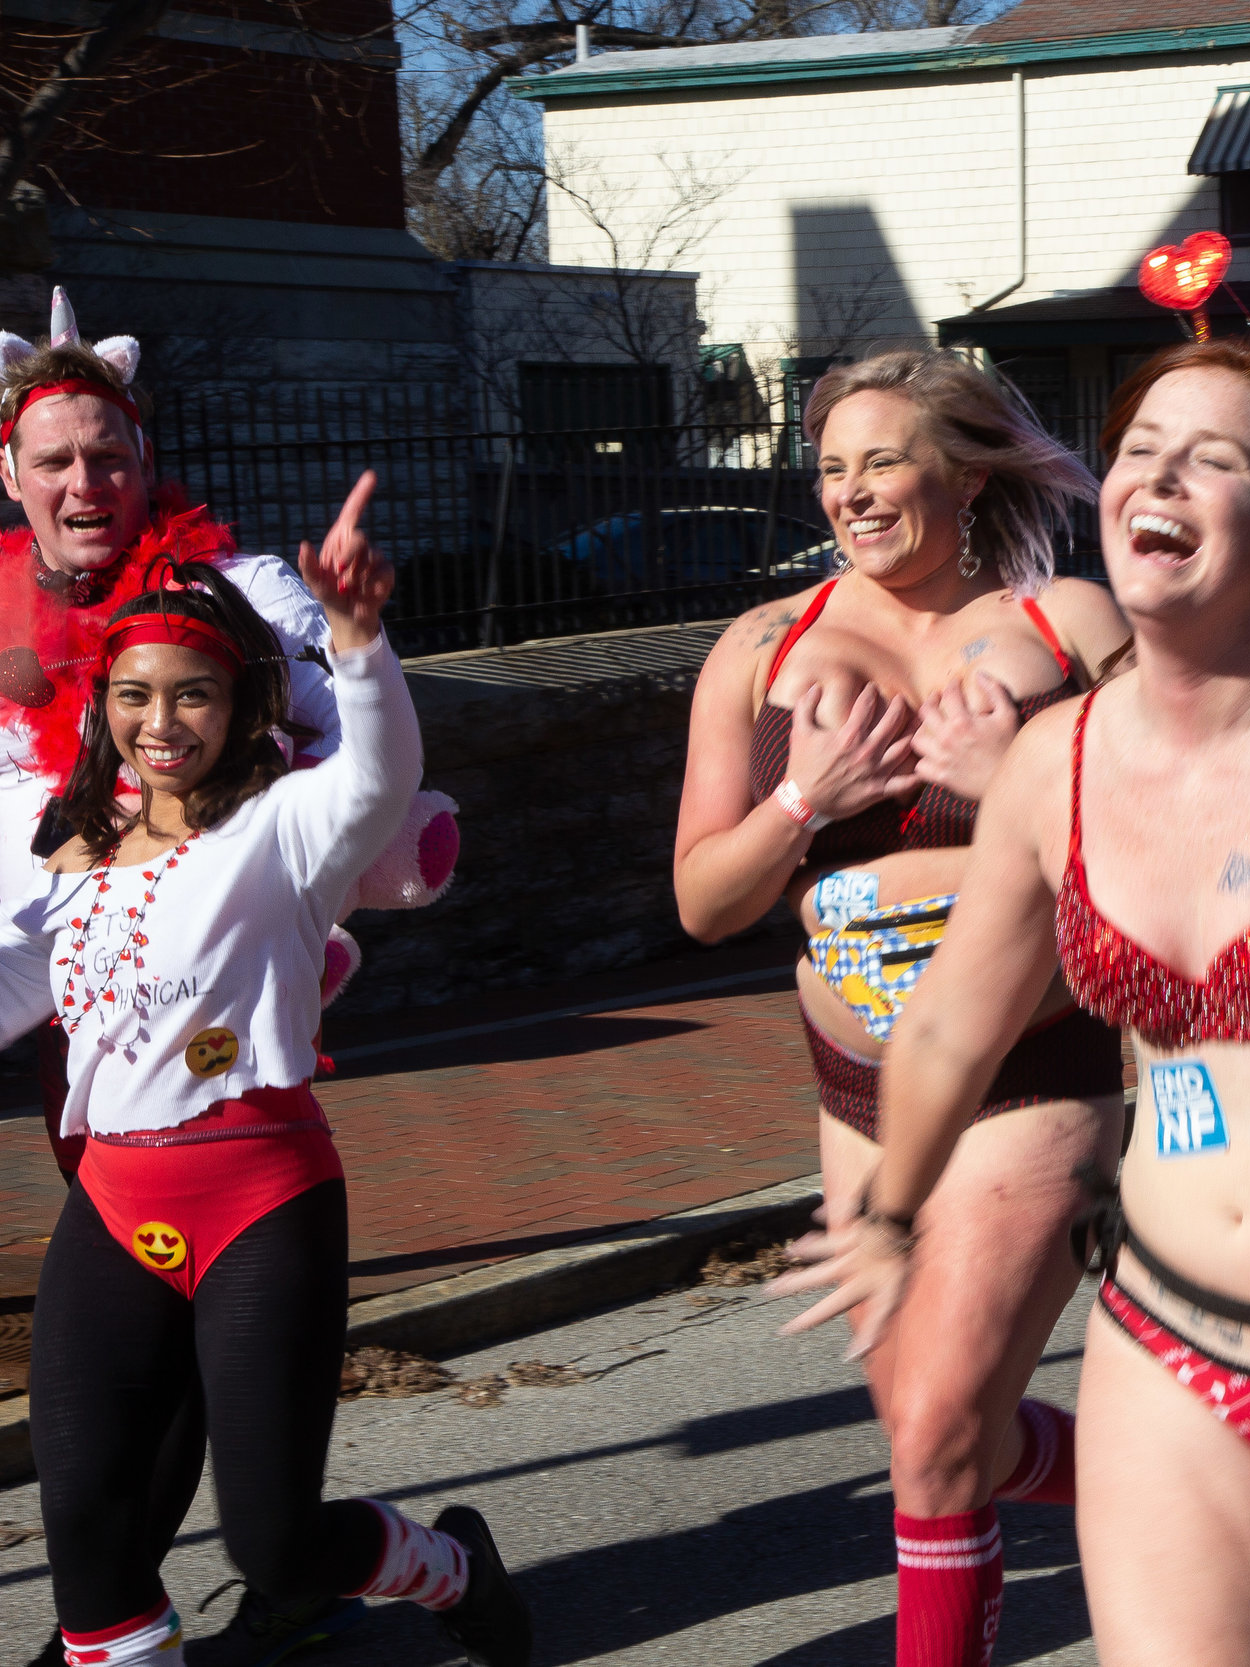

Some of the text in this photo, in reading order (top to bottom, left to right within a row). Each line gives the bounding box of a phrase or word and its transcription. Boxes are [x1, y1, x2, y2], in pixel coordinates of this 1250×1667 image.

[93, 945, 145, 975] GET
[108, 975, 214, 1014] PHYSICAL
[1153, 1066, 1204, 1101] END
[1160, 1106, 1216, 1153] NF
